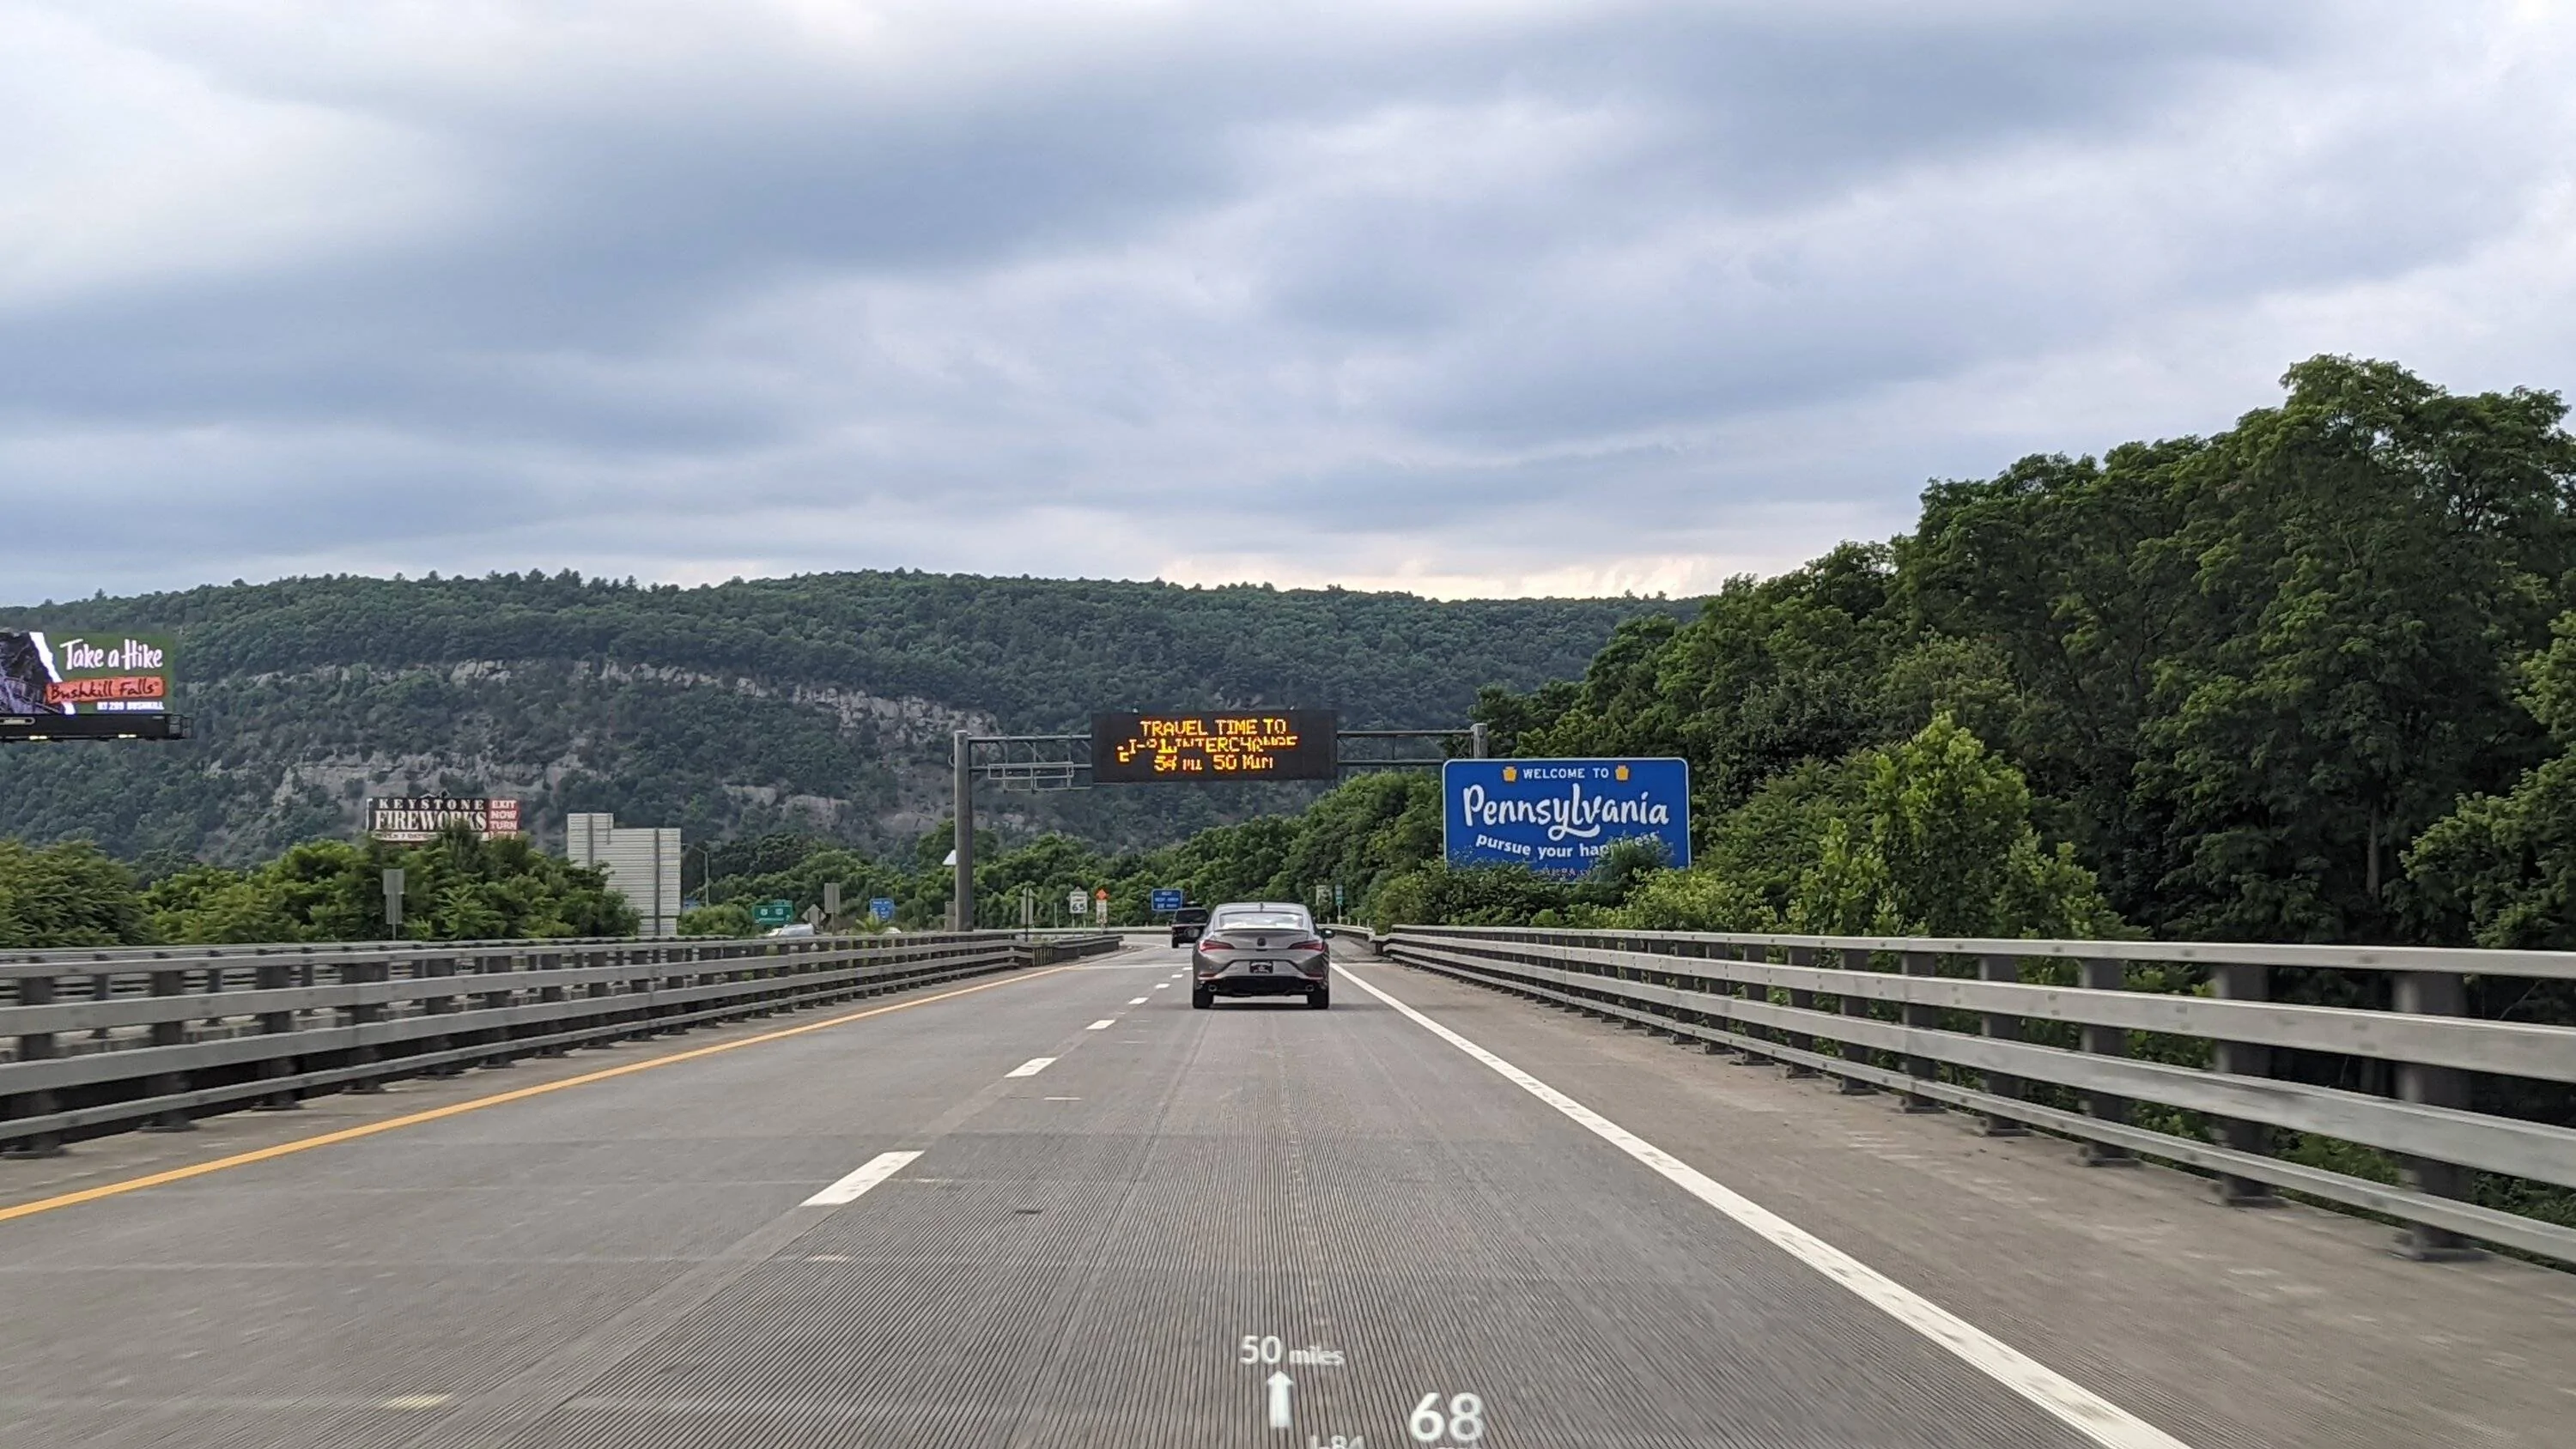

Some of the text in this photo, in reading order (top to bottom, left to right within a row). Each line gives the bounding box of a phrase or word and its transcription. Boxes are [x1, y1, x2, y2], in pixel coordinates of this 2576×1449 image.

[59, 638, 163, 670] Take a Hike
[51, 678, 155, 700] Bushkill Falls
[1139, 718, 1286, 737] TRAVEL TIME TO
[1212, 754, 1237, 770] 50
[1522, 767, 1609, 779] WELCOME TO
[378, 798, 484, 809] KEYSTONE
[492, 799, 517, 809] EXIT
[1462, 782, 1670, 841] Pennsylvania
[490, 809, 517, 819] NOW
[489, 820, 518, 830] TURN
[1475, 833, 1532, 856] pursue
[1537, 845, 1573, 860] your
[1239, 1335, 1345, 1367] 50 miles
[1409, 1392, 1484, 1443] 68
